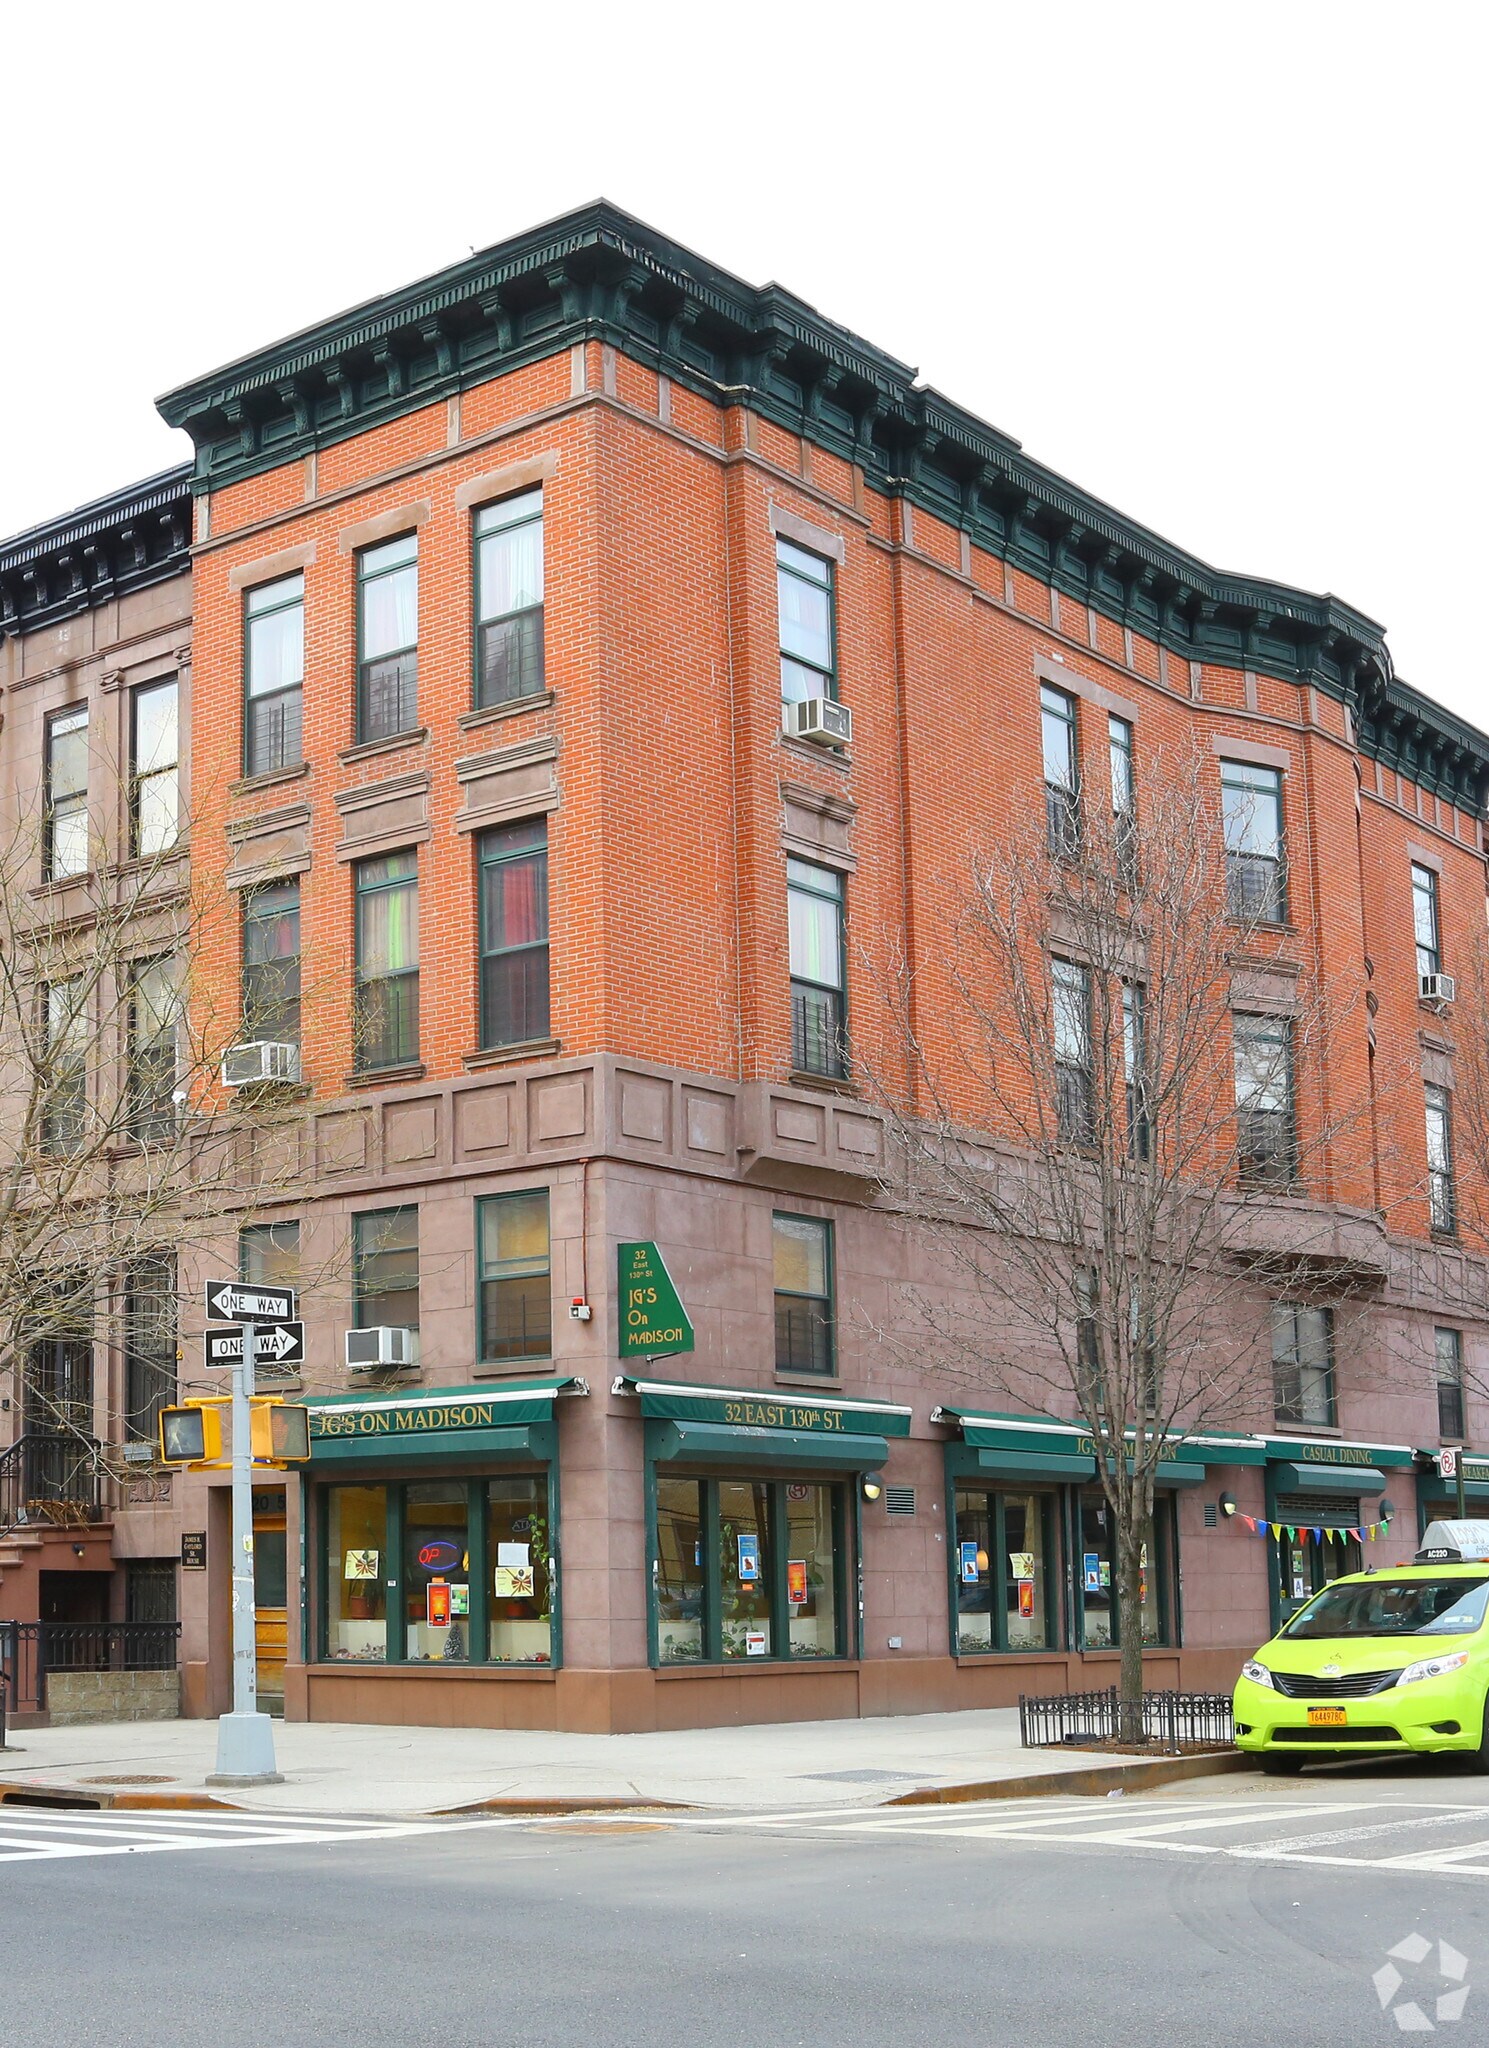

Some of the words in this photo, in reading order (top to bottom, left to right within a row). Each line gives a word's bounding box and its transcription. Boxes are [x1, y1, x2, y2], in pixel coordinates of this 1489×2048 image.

[634, 1250, 646, 1260] 32
[633, 1261, 648, 1269] East
[221, 1294, 245, 1310] ONE
[257, 1298, 282, 1314] WAY
[629, 1287, 657, 1308] JG'S
[628, 1310, 648, 1325] On
[260, 1335, 288, 1351] WAY
[628, 1328, 682, 1345] MADISON
[176, 1350, 183, 1360] 2
[319, 1413, 355, 1435] JG'S
[360, 1412, 391, 1432] ON
[395, 1404, 493, 1430] MADISON
[725, 1403, 741, 1421] 32
[744, 1404, 787, 1425] EAST
[789, 1408, 820, 1427] 130th
[823, 1410, 844, 1430] ST.
[1302, 1445, 1338, 1462] CASUAL
[1340, 1448, 1373, 1464] DINING
[1427, 1549, 1448, 1558] AC220
